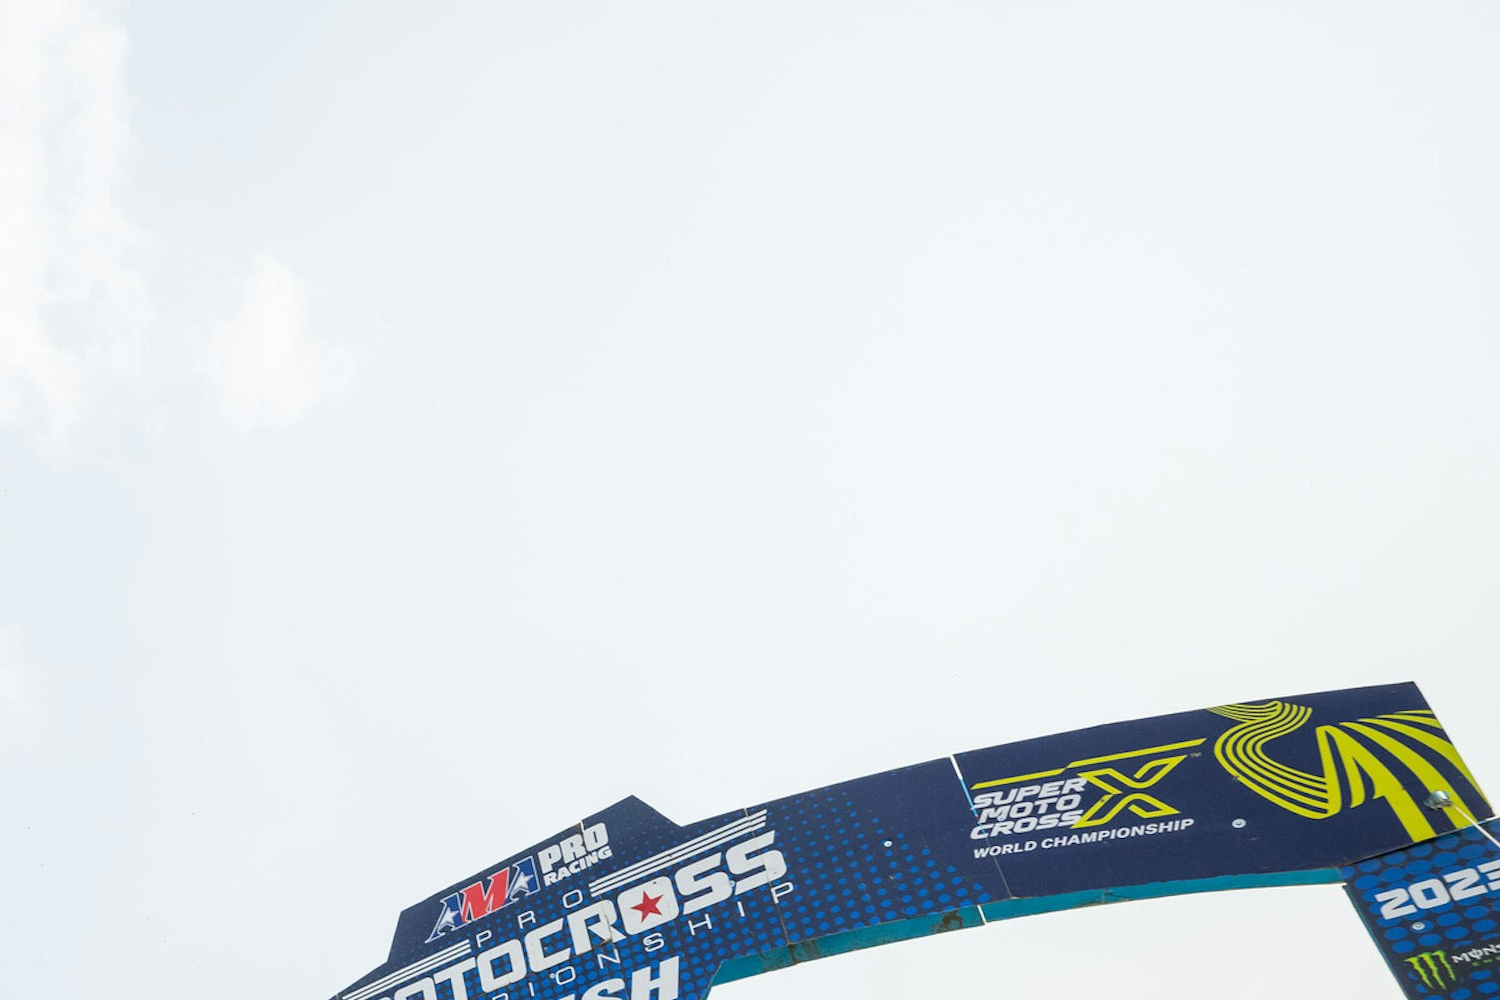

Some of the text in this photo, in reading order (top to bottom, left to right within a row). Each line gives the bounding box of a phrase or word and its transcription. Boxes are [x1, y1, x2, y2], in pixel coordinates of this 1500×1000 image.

[972, 777, 1087, 809] SUPER
[978, 794, 1081, 824] MOTO
[970, 810, 1083, 840] CROSS
[974, 818, 1195, 859] WORLD CHAMPIONSHIP
[424, 822, 610, 944] AMA PRO
[543, 846, 613, 886] RACING
[476, 889, 584, 948] PRO
